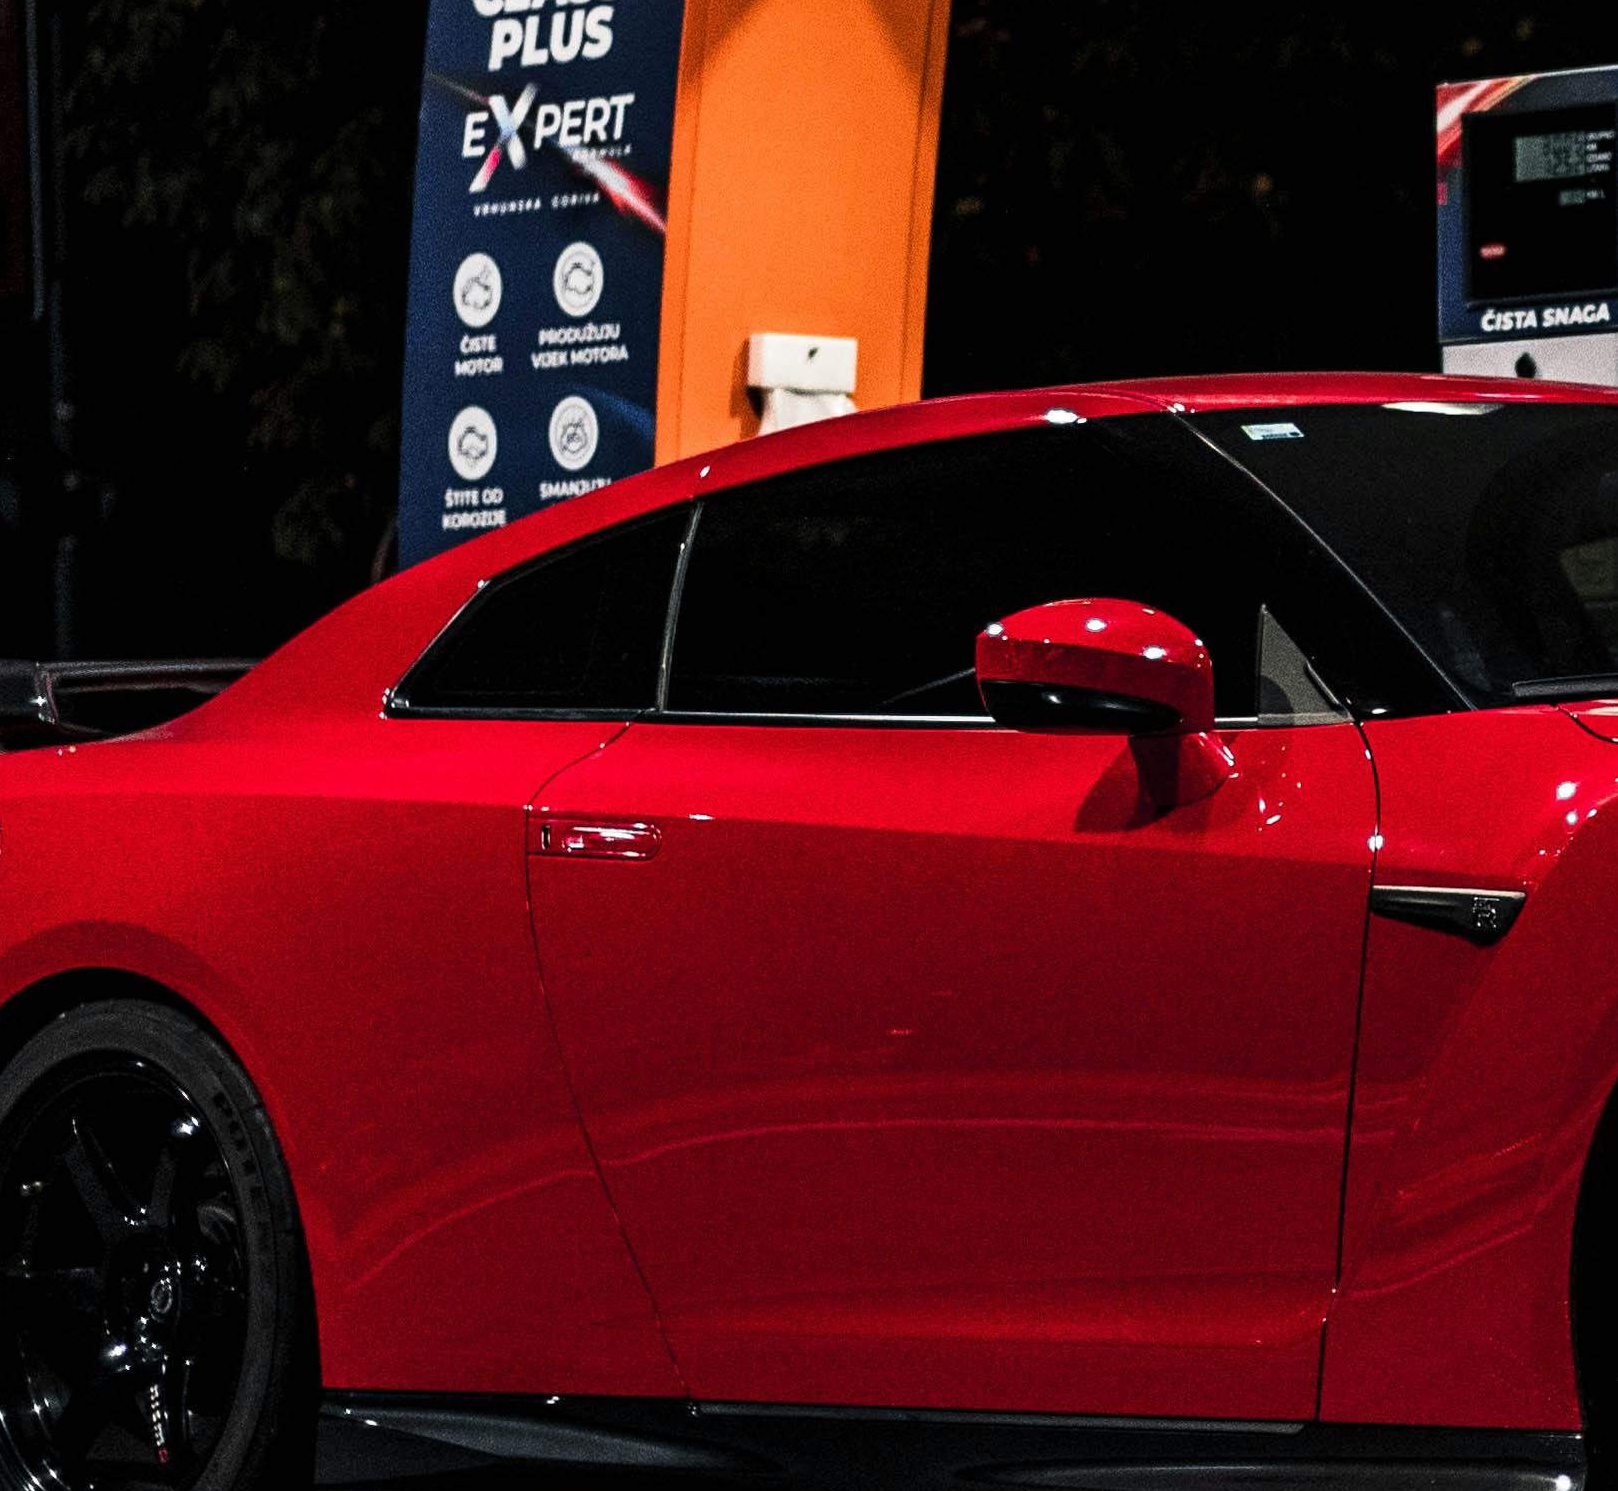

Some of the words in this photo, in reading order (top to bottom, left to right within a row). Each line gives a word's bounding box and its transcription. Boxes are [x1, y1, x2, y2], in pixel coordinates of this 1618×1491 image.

[488, 5, 615, 71] PLUS
[462, 82, 635, 193] EXPERT
[1481, 307, 1537, 332] ČISTA
[1543, 303, 1610, 327] SNAGA
[454, 357, 503, 377] MOTOR
[570, 344, 629, 366] MOTORA
